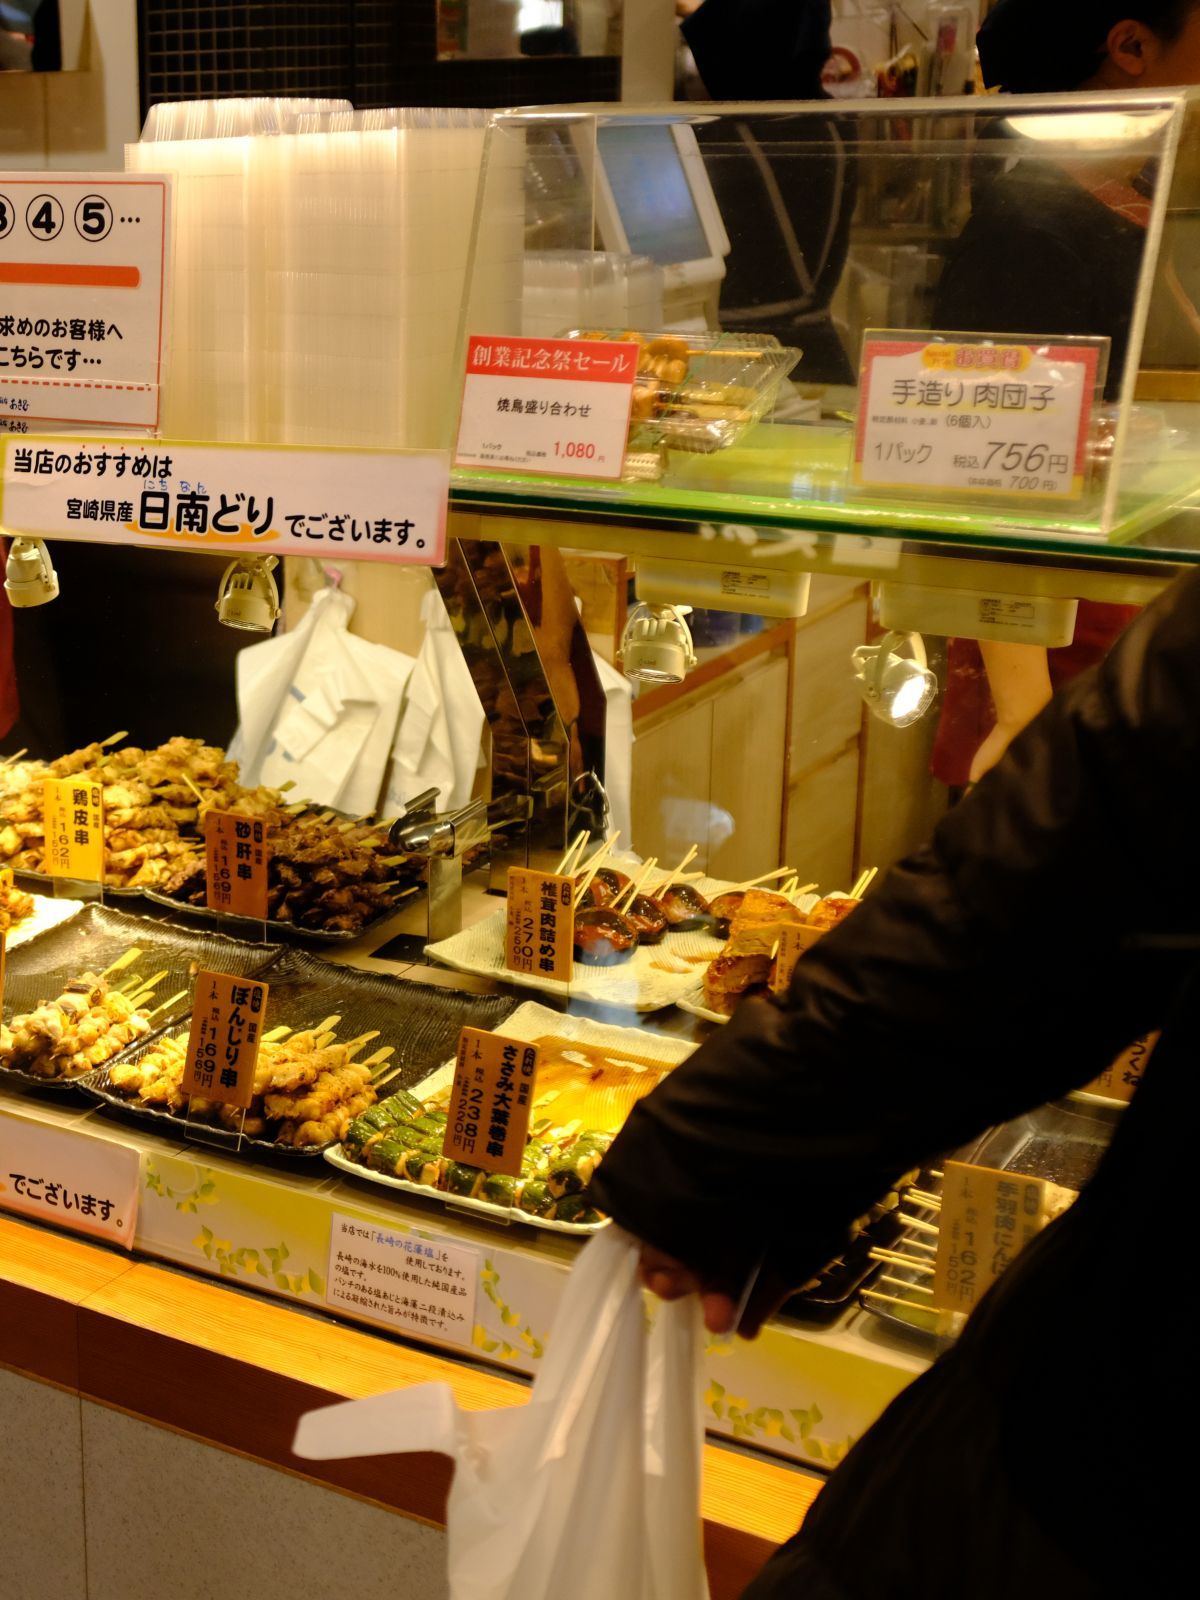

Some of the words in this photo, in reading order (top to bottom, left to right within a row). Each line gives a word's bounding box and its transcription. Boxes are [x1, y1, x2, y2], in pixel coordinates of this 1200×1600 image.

[472, 344, 630, 373] 創業記念祭セール
[497, 397, 592, 418] 焼鳥盛り合わせ
[892, 379, 965, 407] 手造り
[973, 383, 1056, 411] 肉団子
[13, 449, 173, 478] 当店のおすすめは
[554, 441, 596, 459] 1,080
[875, 441, 933, 464] 1パック
[953, 454, 980, 469] 税込
[983, 441, 1069, 474] 756円
[66, 497, 134, 523] 宮崎県産
[140, 490, 275, 535] 日南どり
[285, 513, 426, 549] でございます。
[72, 789, 89, 846] 鶏皮串
[235, 821, 253, 880] 砂肝串
[522, 917, 534, 971] 270円
[538, 880, 558, 973] 椎茸肉詰め串
[201, 1027, 217, 1088] 169円
[219, 984, 251, 1088] ぼんじり串
[246, 1022, 257, 1044] 国産
[486, 1045, 519, 1157] ささみ大葉巻串
[517, 1083, 530, 1106] 国産
[463, 1088, 484, 1154] 238円
[8, 1172, 123, 1228] でございます。
[334, 1263, 367, 1282] の塩です。
[336, 1250, 468, 1297] 長崎の海水を100%使用した純国産品
[405, 1255, 466, 1281] 使用しております。
[960, 1231, 977, 1303] 162円
